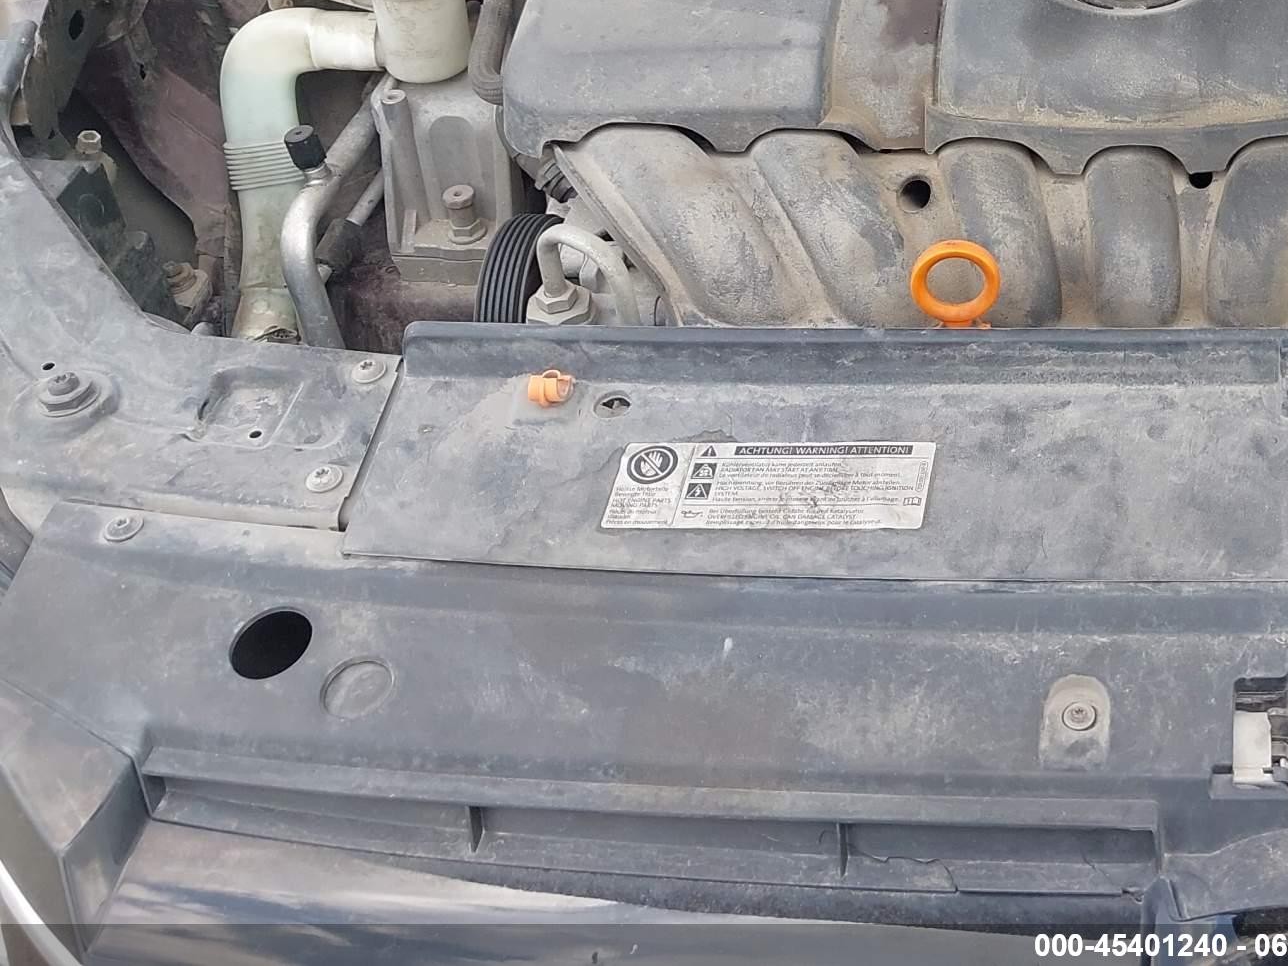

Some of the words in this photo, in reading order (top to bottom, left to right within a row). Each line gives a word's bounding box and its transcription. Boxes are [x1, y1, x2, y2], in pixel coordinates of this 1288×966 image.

[739, 446, 794, 455] ACHTUNG!
[796, 446, 849, 455] WARNING!
[850, 446, 910, 455] ATTENTION!
